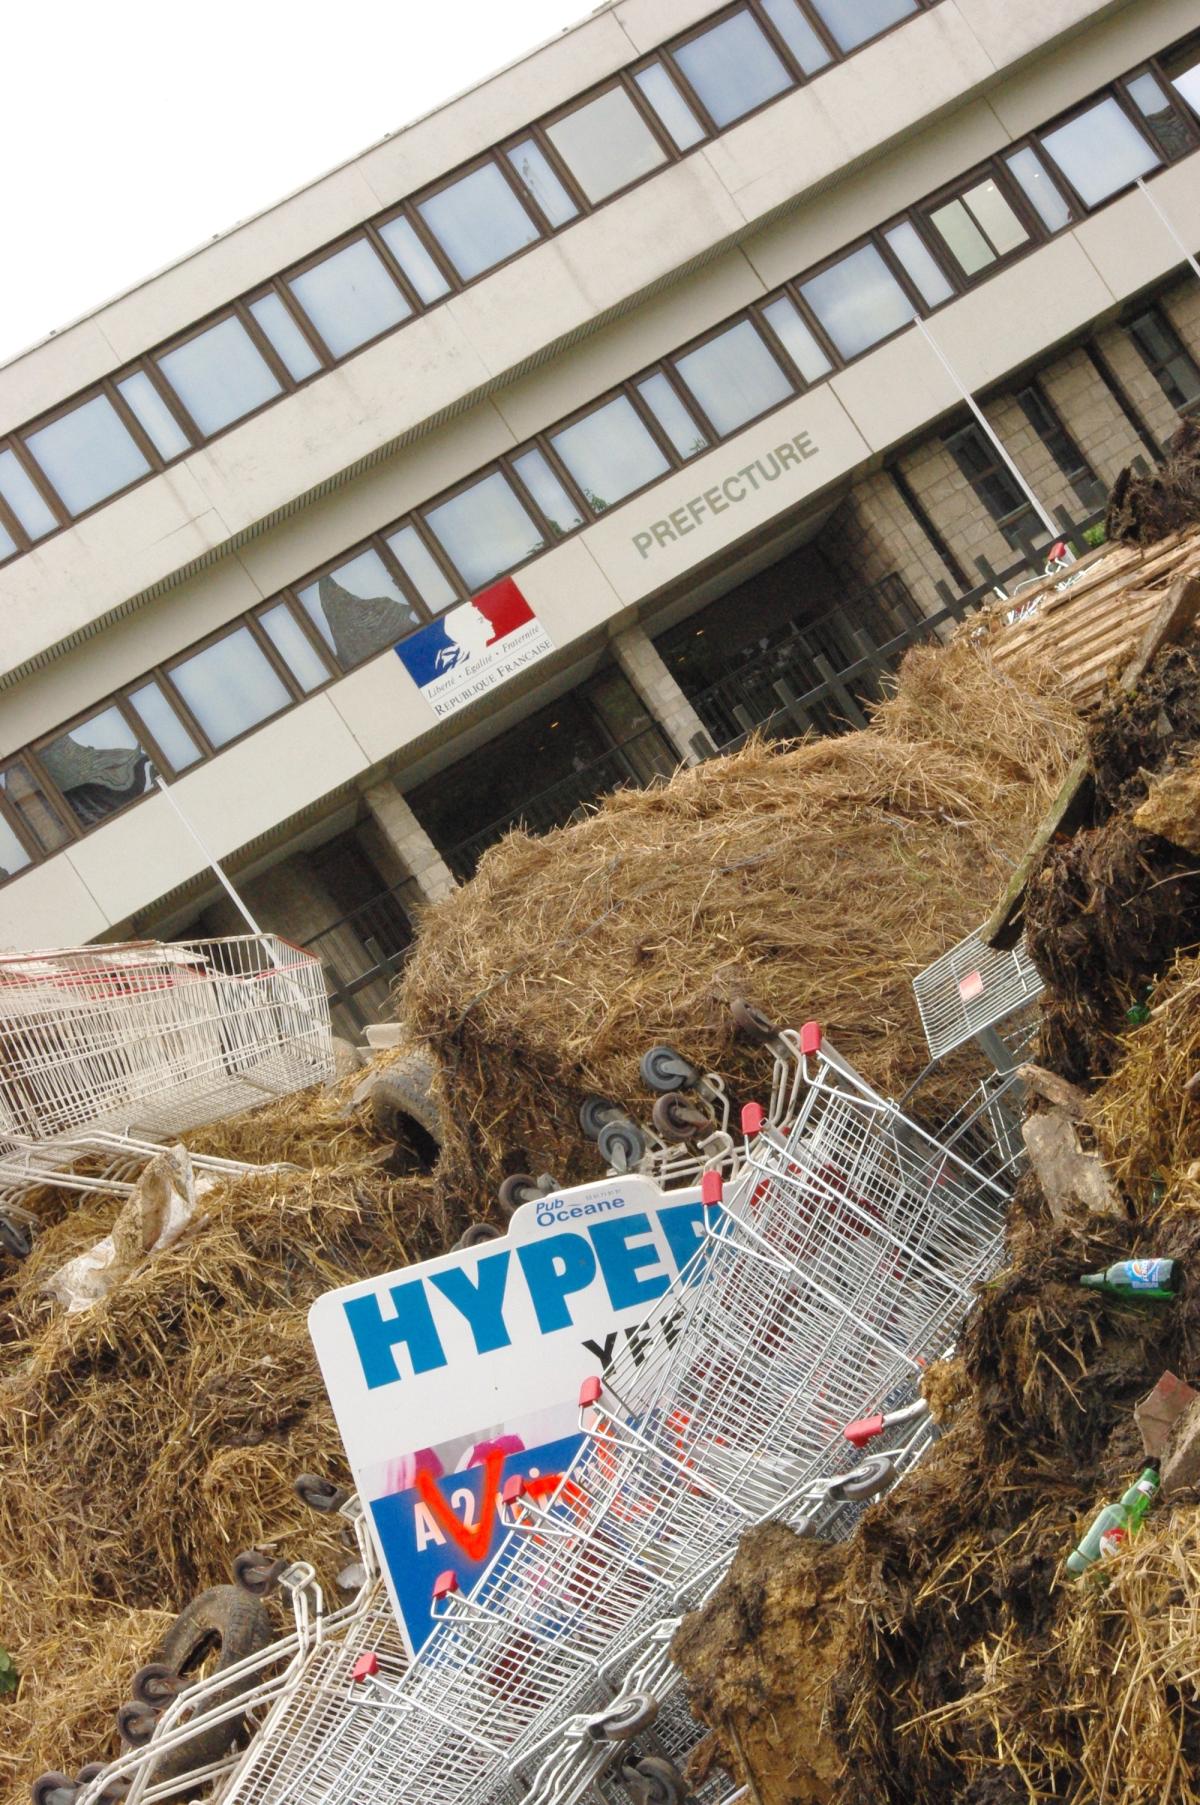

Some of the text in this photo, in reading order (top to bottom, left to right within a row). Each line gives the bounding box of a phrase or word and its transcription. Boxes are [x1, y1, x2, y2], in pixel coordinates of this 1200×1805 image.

[632, 430, 820, 560] PREFECTURE
[536, 1199, 564, 1214] Pub
[451, 1487, 480, 1535] 2
